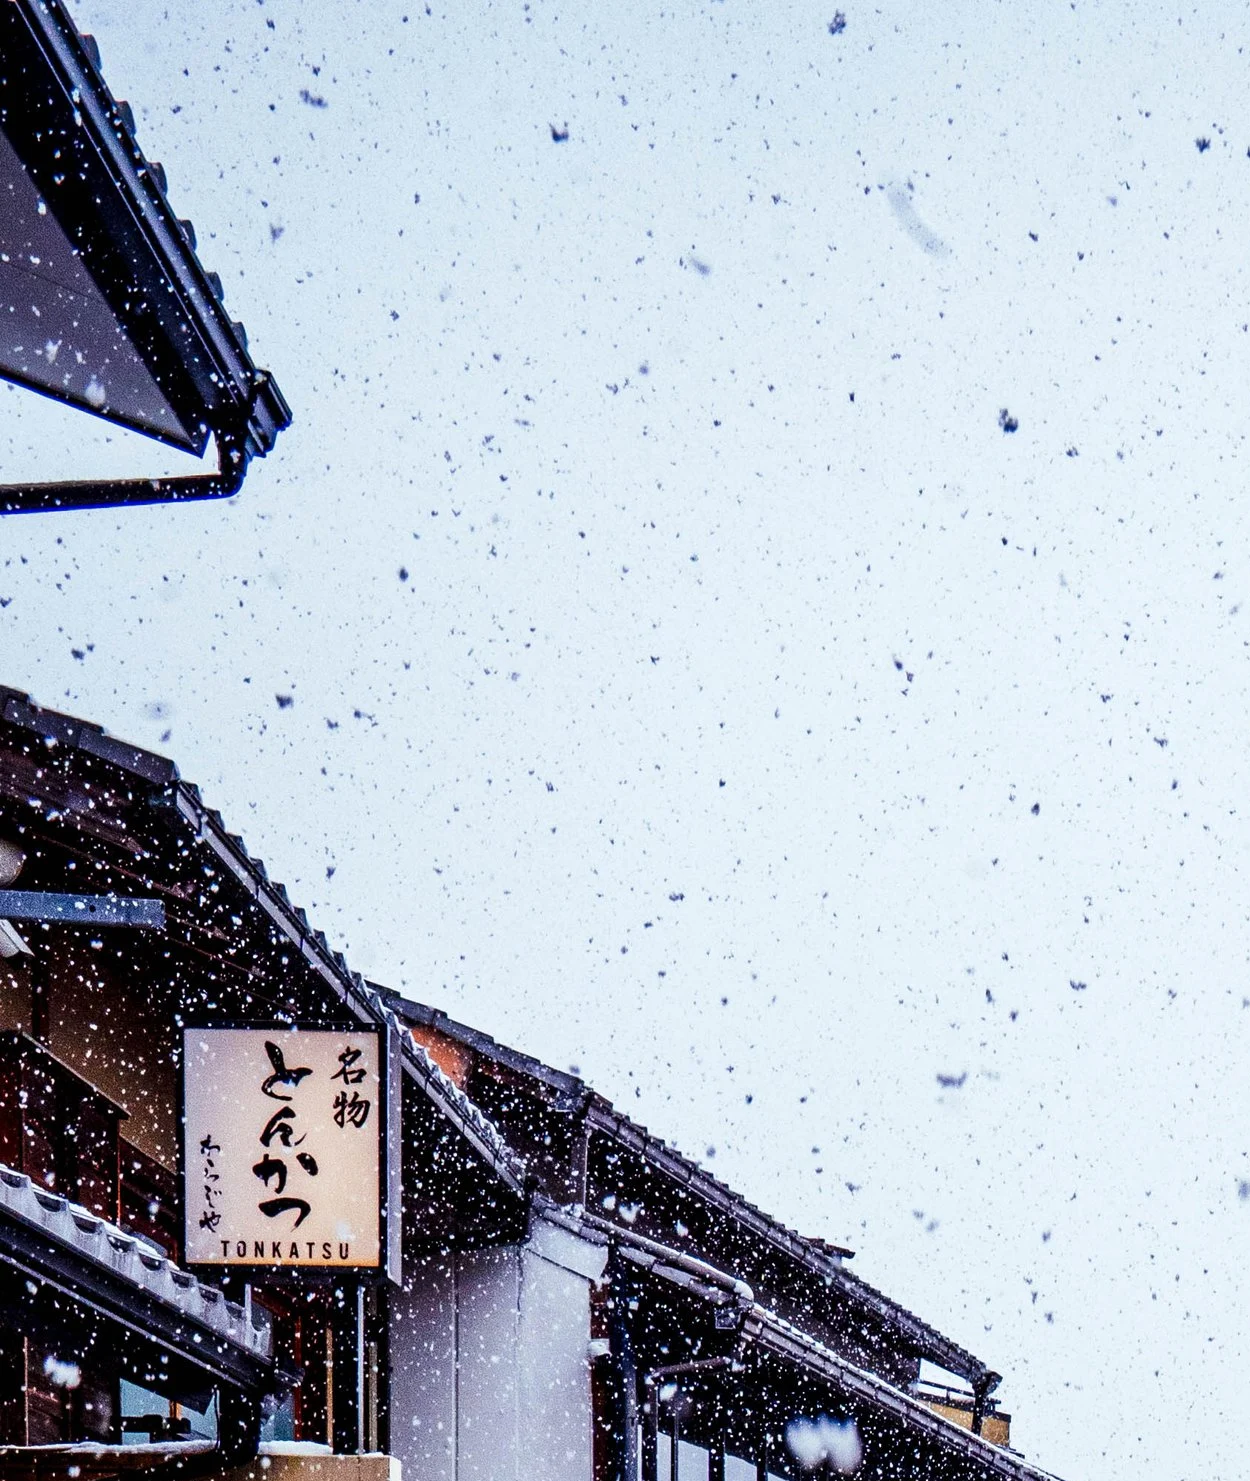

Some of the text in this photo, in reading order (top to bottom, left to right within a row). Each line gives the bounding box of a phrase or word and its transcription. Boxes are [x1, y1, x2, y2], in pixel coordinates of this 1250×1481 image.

[330, 1046, 371, 1128] 名物
[252, 1040, 319, 1233] とんかつ
[199, 1134, 222, 1233] わらじや
[221, 1240, 349, 1260] TONKATSU
